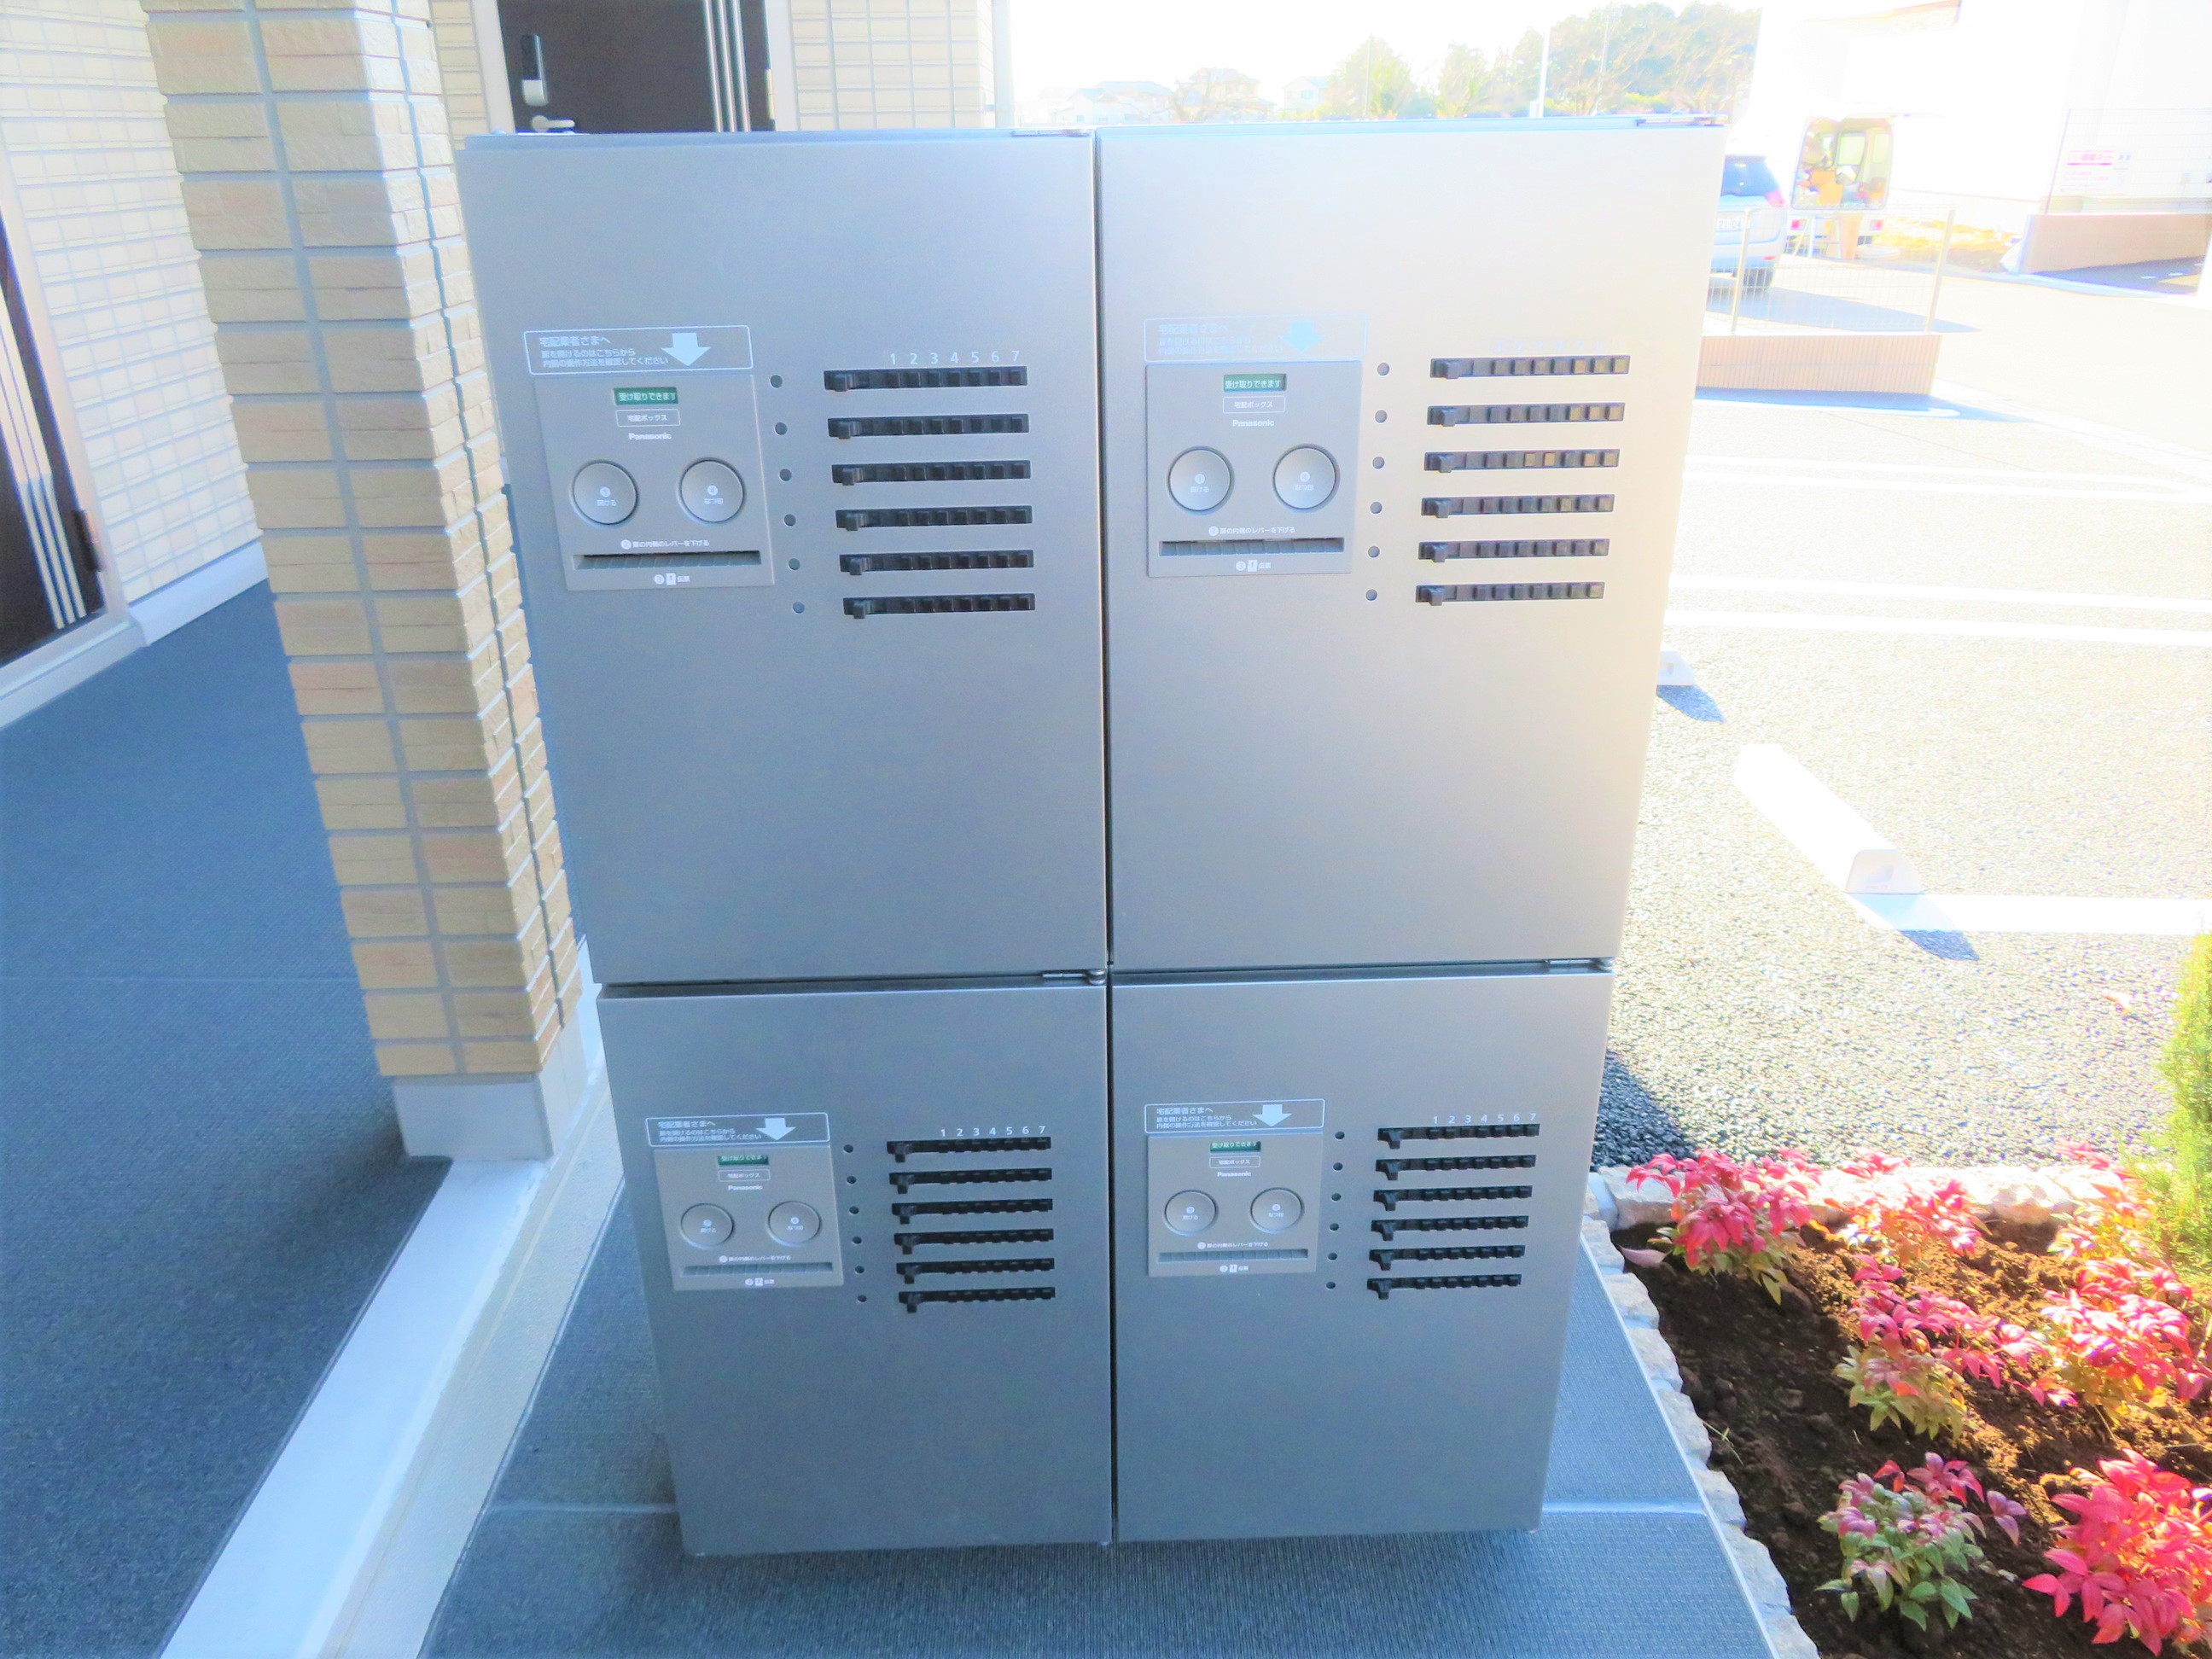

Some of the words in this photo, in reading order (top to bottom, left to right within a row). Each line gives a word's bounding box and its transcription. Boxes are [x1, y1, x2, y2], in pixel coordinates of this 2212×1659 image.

[539, 335, 611, 347] 宅配業者さまへ
[890, 353, 896, 365] 1
[910, 353, 918, 365] 2
[930, 352, 939, 364] 3
[951, 352, 959, 364] 4
[971, 351, 980, 363] 5
[991, 351, 999, 363] 6
[1011, 350, 1020, 362] 7
[1225, 379, 1281, 389] 受け取りできます
[619, 392, 677, 402] 受け取りできます
[1234, 400, 1273, 409] 宅配ボックス
[627, 413, 667, 422] 宅配ボックス
[628, 432, 672, 440] Panasonic
[1448, 1115, 1455, 1124] 2
[1498, 1114, 1505, 1122] 5
[1529, 1113, 1537, 1121] 7
[957, 1128, 963, 1137] 2
[1006, 1126, 1013, 1135] 5
[1039, 1126, 1045, 1134] 7
